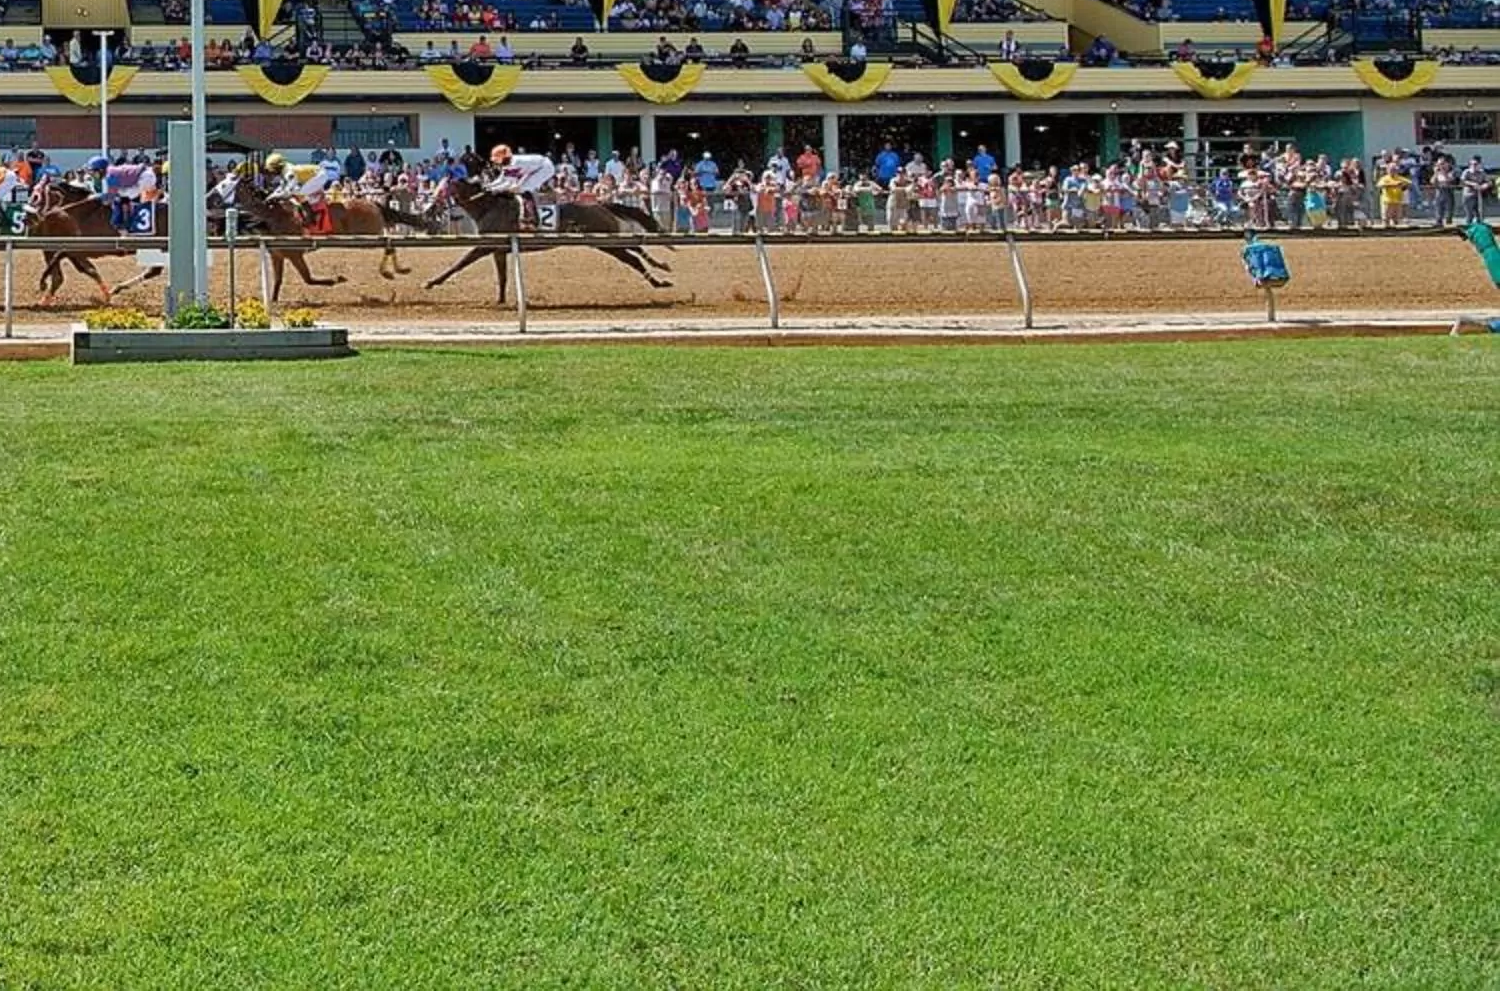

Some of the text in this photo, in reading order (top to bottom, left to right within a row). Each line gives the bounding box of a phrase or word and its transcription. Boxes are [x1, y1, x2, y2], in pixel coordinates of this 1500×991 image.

[11, 212, 26, 234] 5
[137, 208, 151, 230] 3
[541, 207, 554, 227] 2
